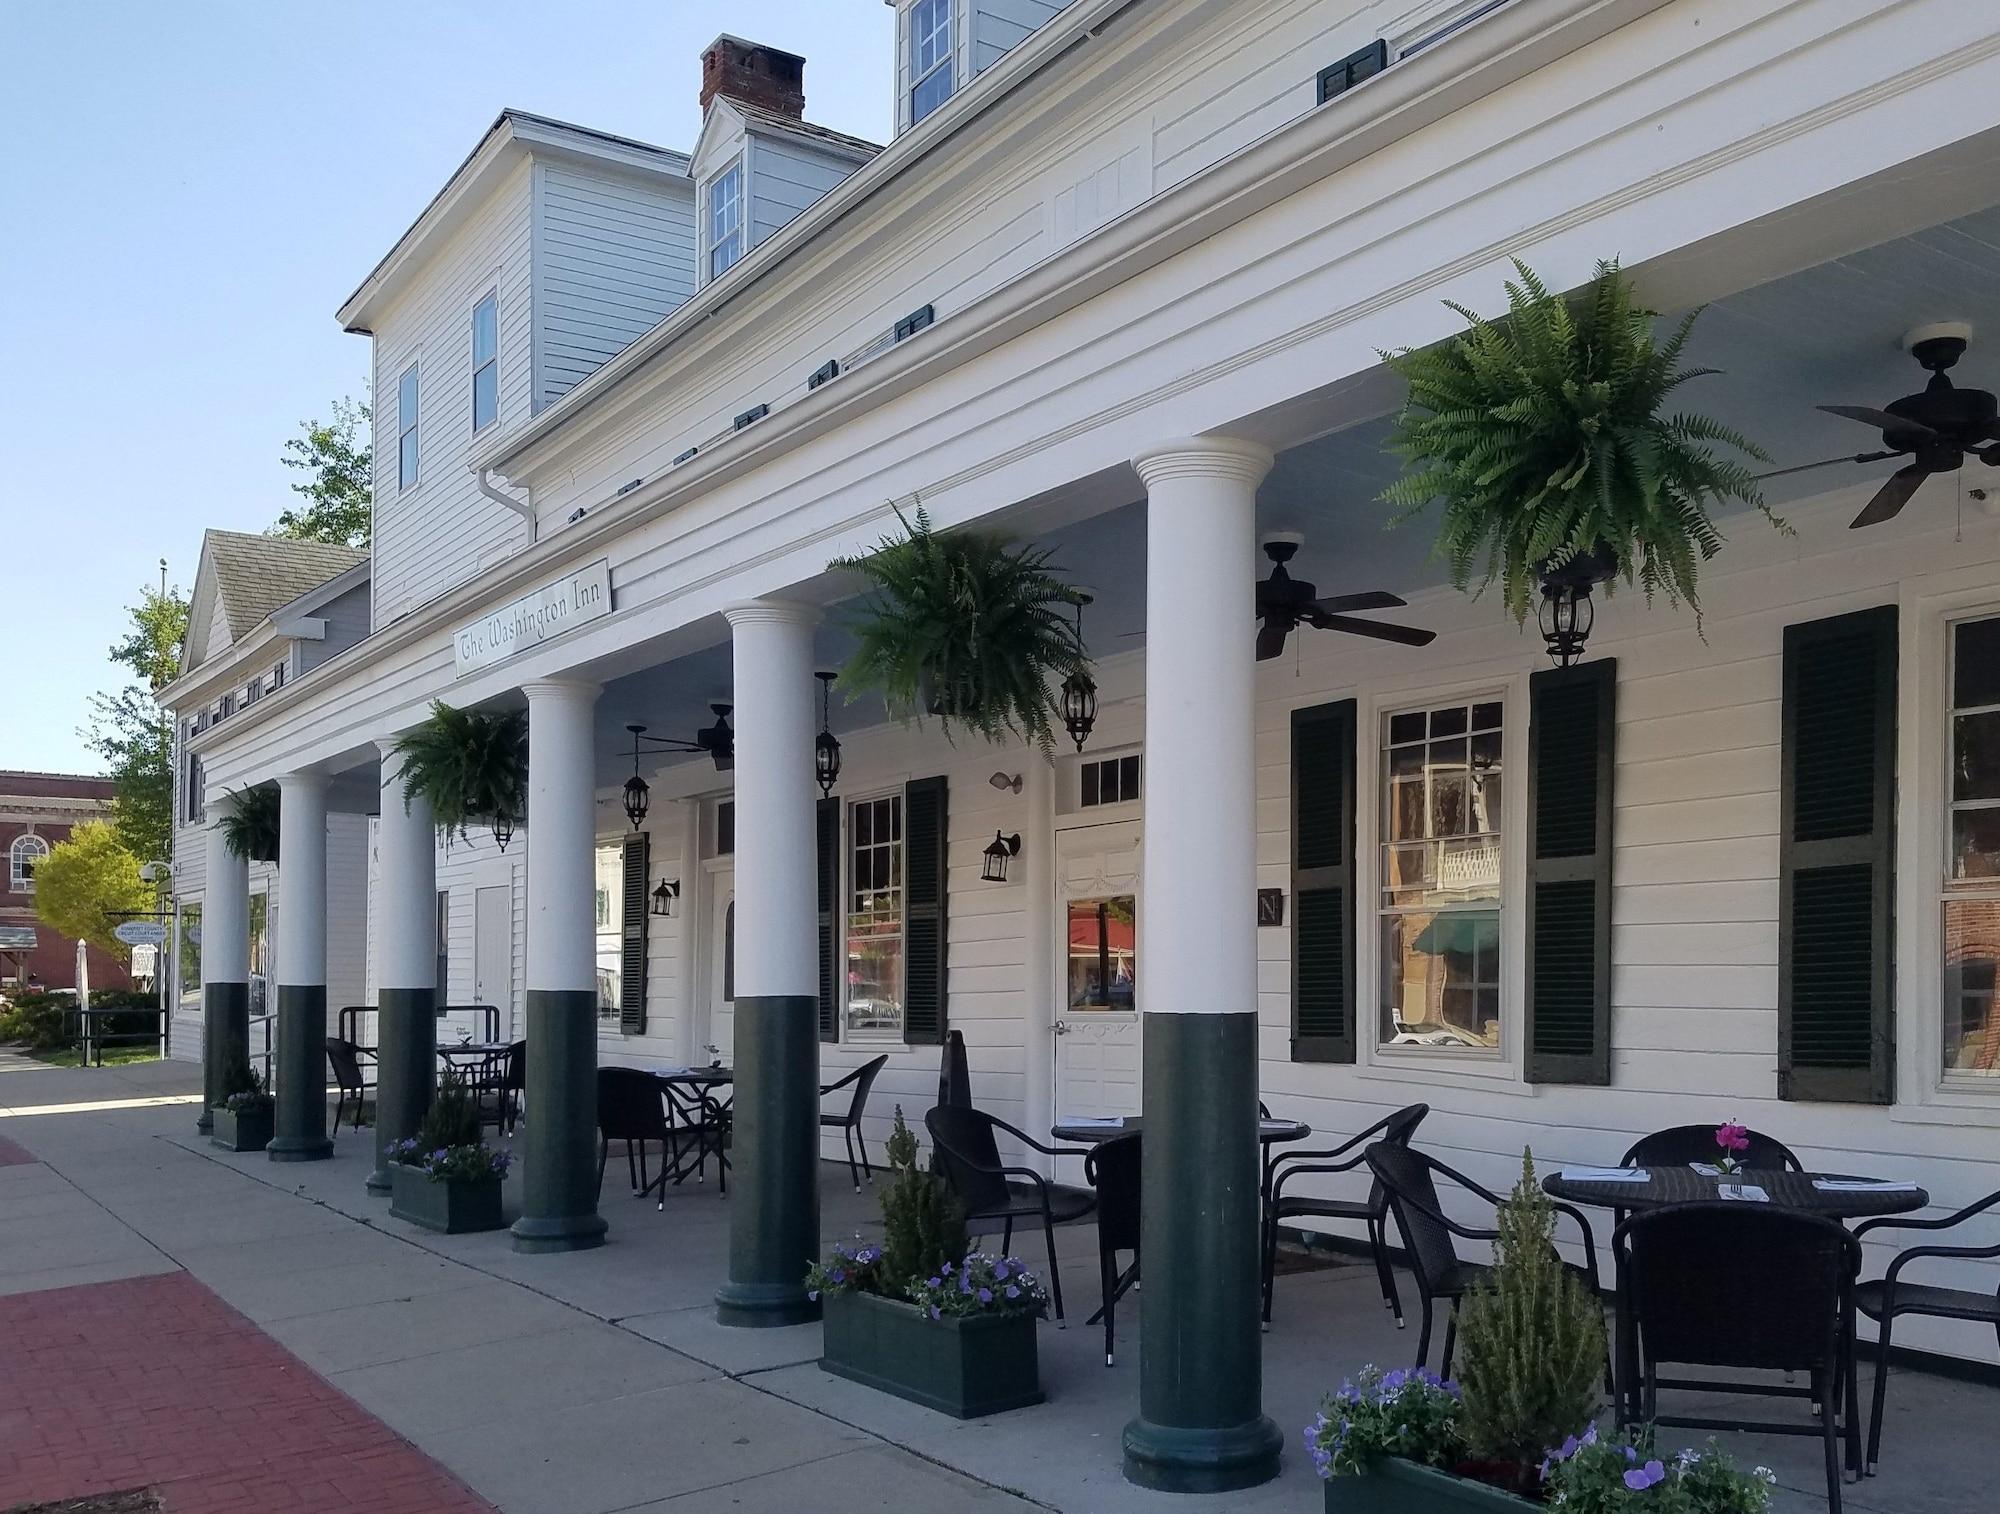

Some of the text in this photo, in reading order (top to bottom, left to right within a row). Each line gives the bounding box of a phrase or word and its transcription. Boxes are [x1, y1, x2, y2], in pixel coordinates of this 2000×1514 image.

[460, 578, 601, 661] The Washington Inn
